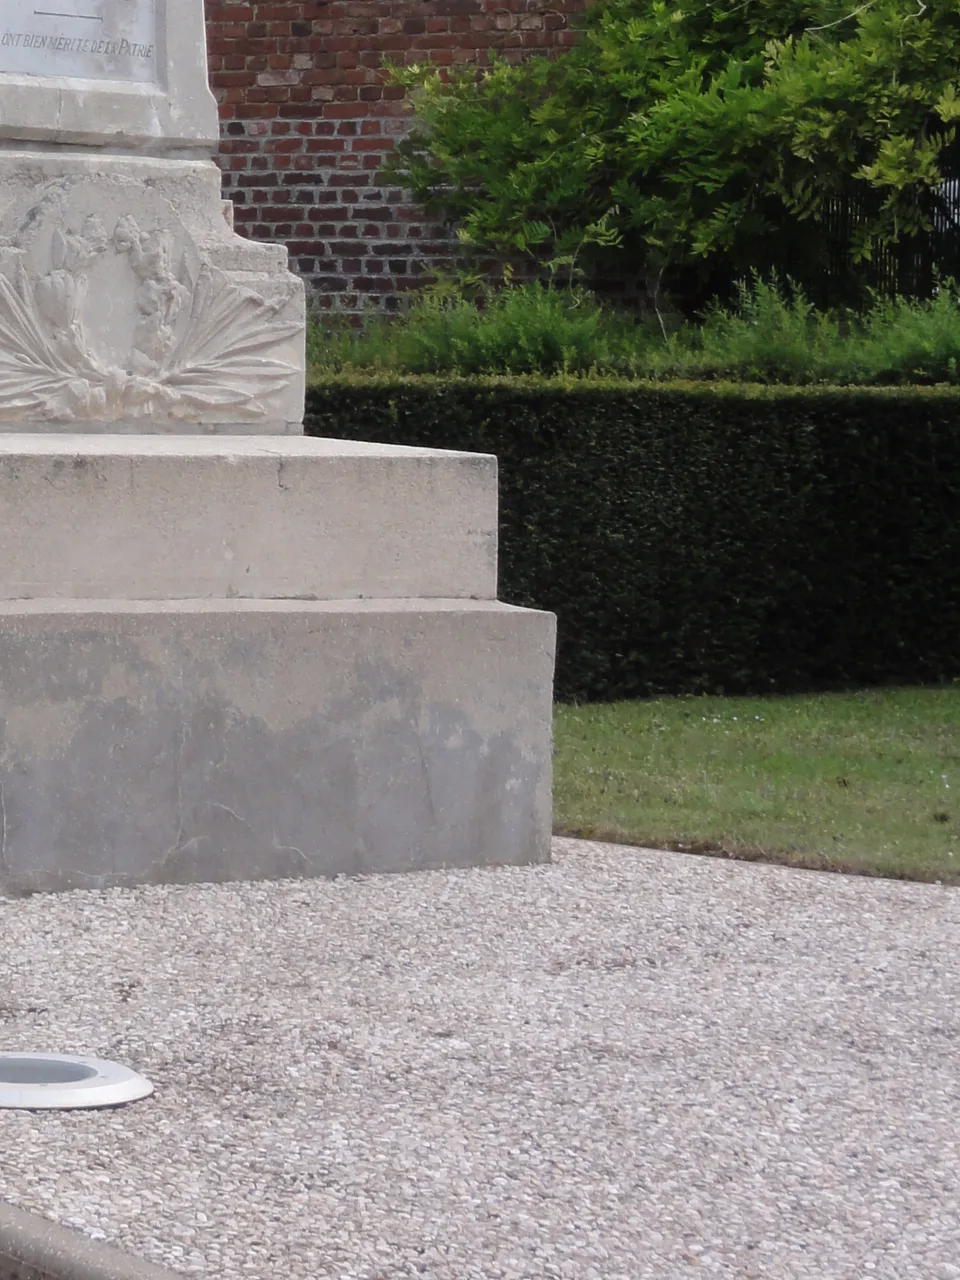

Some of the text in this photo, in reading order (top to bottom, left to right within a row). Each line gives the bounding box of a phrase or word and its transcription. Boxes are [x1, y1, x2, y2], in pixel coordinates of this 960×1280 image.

[23, 34, 47, 49] BIEN
[90, 40, 104, 54] DE
[119, 37, 154, 58] PATRIE
